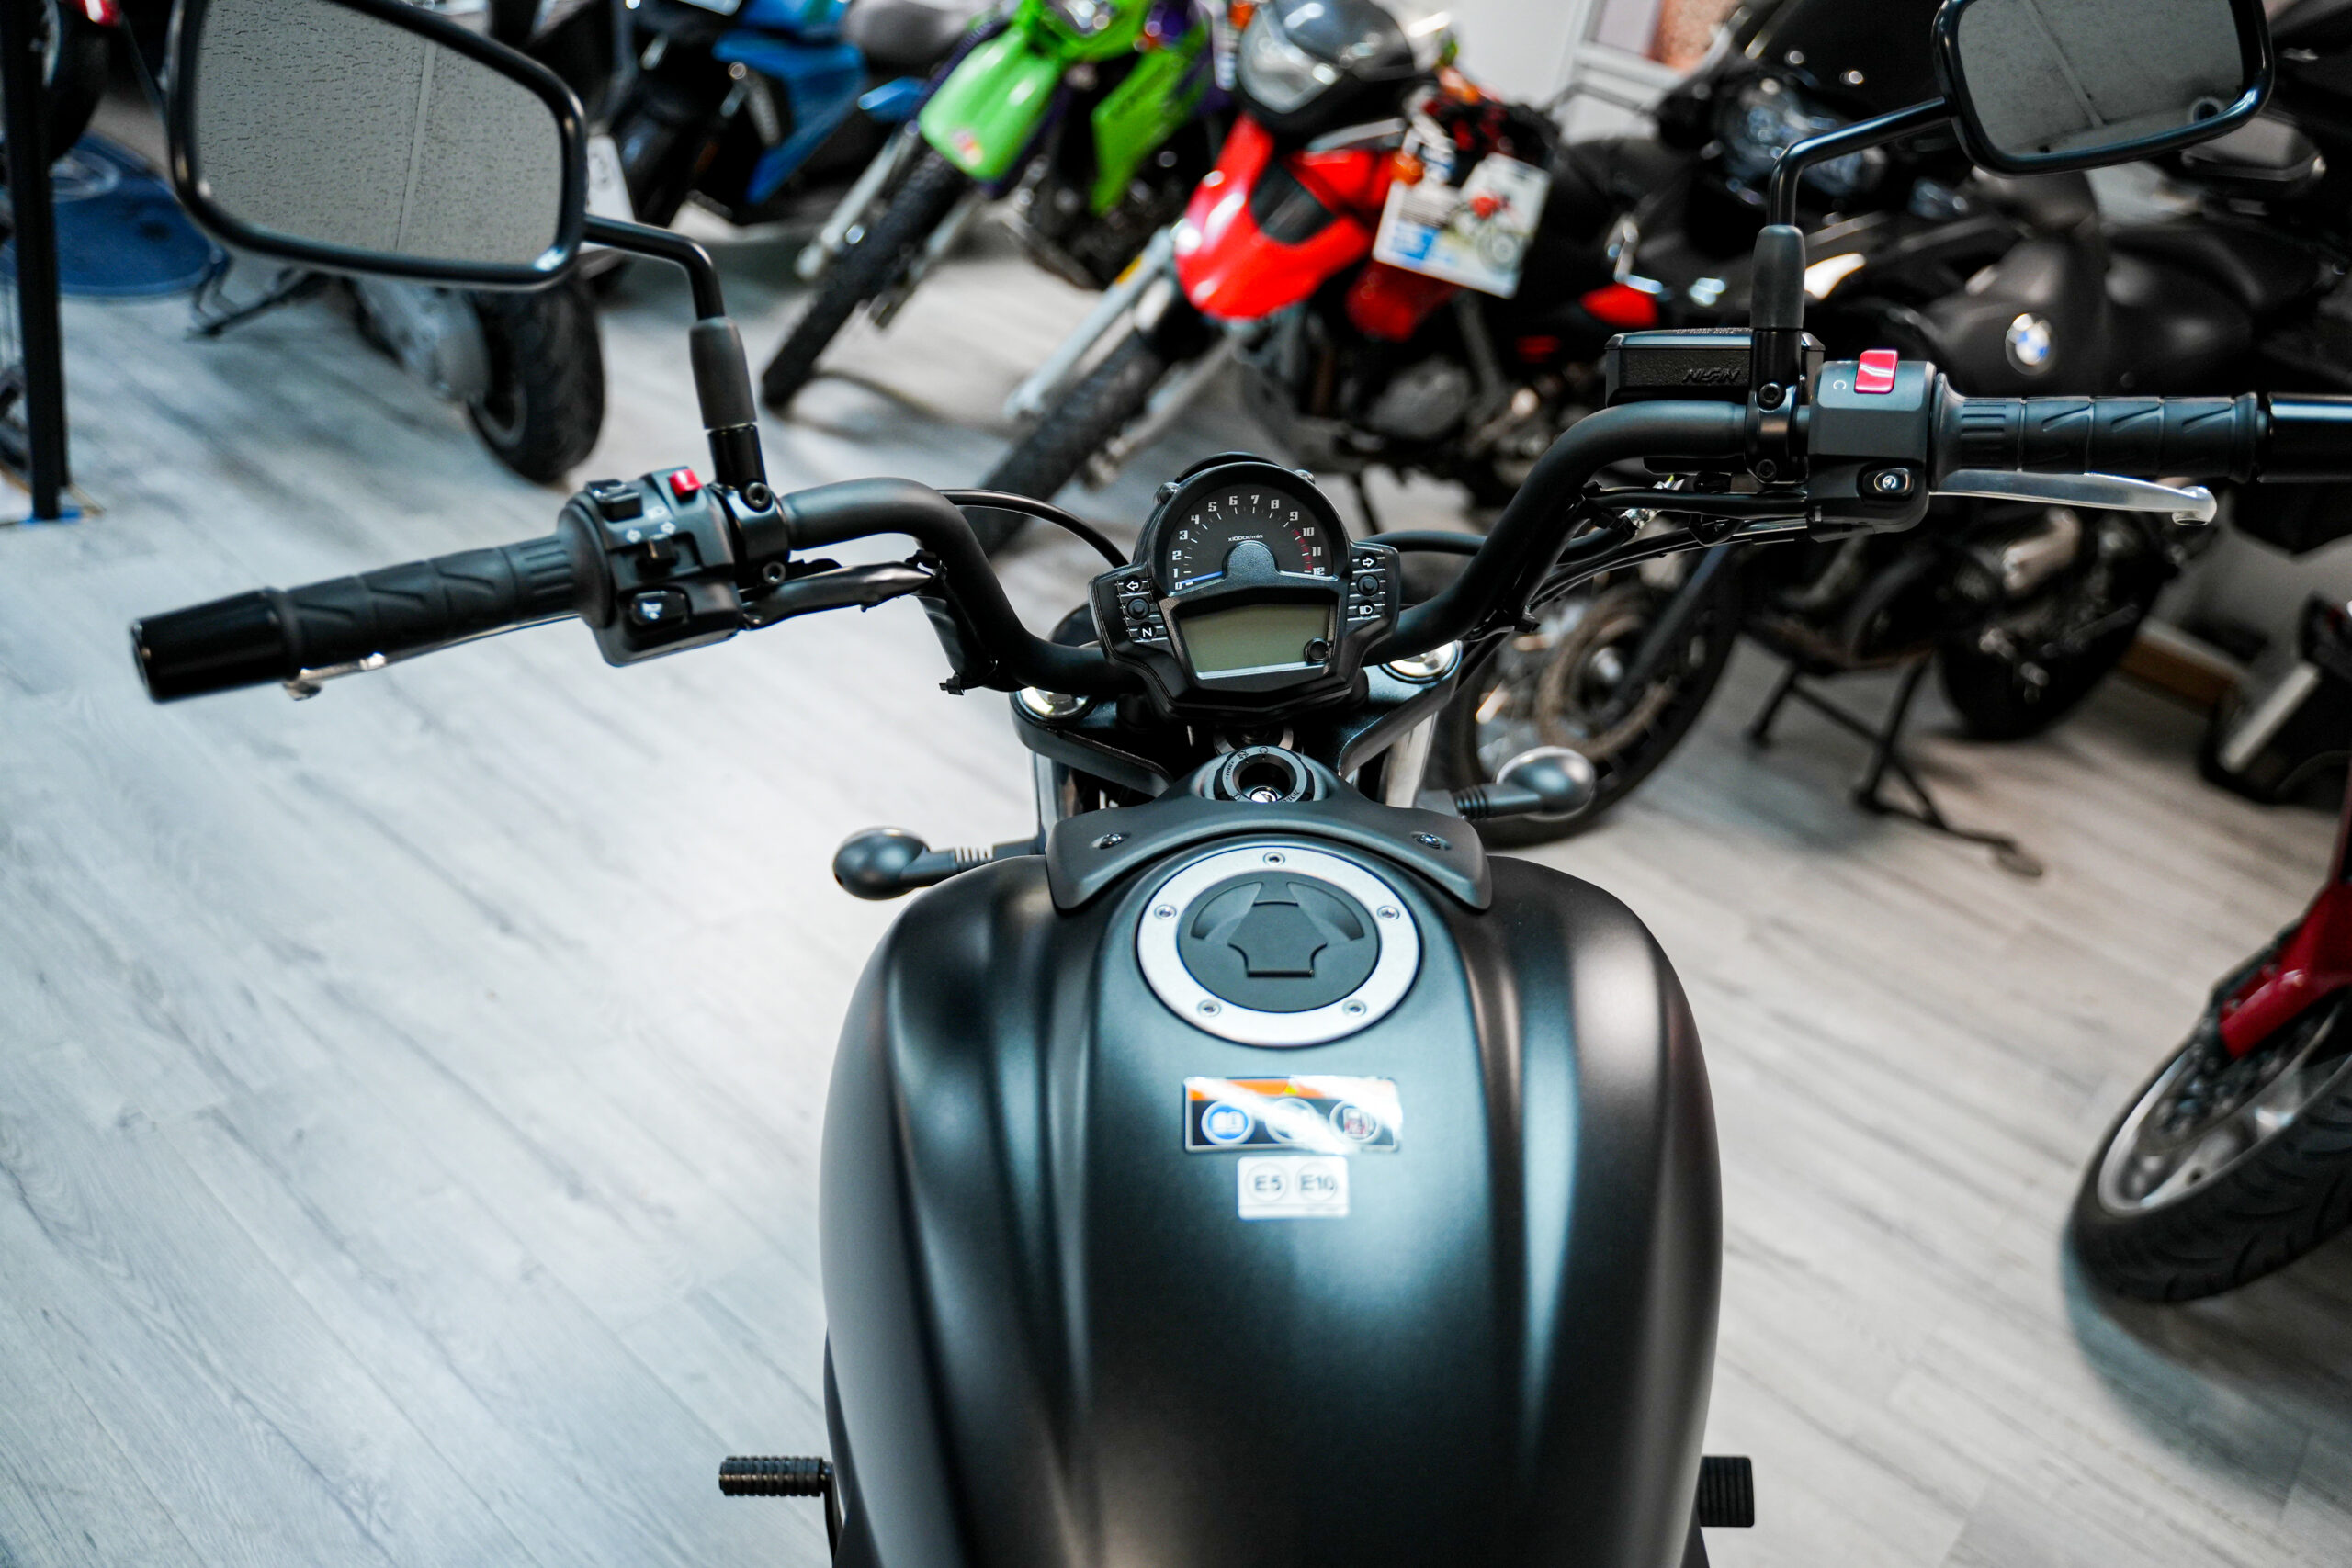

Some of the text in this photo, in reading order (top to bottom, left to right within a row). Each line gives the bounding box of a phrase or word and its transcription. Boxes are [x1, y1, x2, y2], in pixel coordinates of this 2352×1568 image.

[1228, 495, 1238, 506] 6
[1250, 494, 1260, 505] 7
[1271, 499, 1280, 510] 8
[1207, 502, 1217, 513] 5
[1190, 513, 1200, 525] 4
[1289, 511, 1299, 522] 9
[1179, 529, 1189, 541] 3
[1302, 526, 1315, 537] 10
[1171, 549, 1182, 561] 2
[1312, 546, 1322, 558] 11
[1172, 568, 1179, 579] 1
[1312, 566, 1326, 576] 12
[1174, 581, 1183, 591] 0
[1141, 626, 1153, 638] N
[1254, 1175, 1336, 1191] E5 E10
